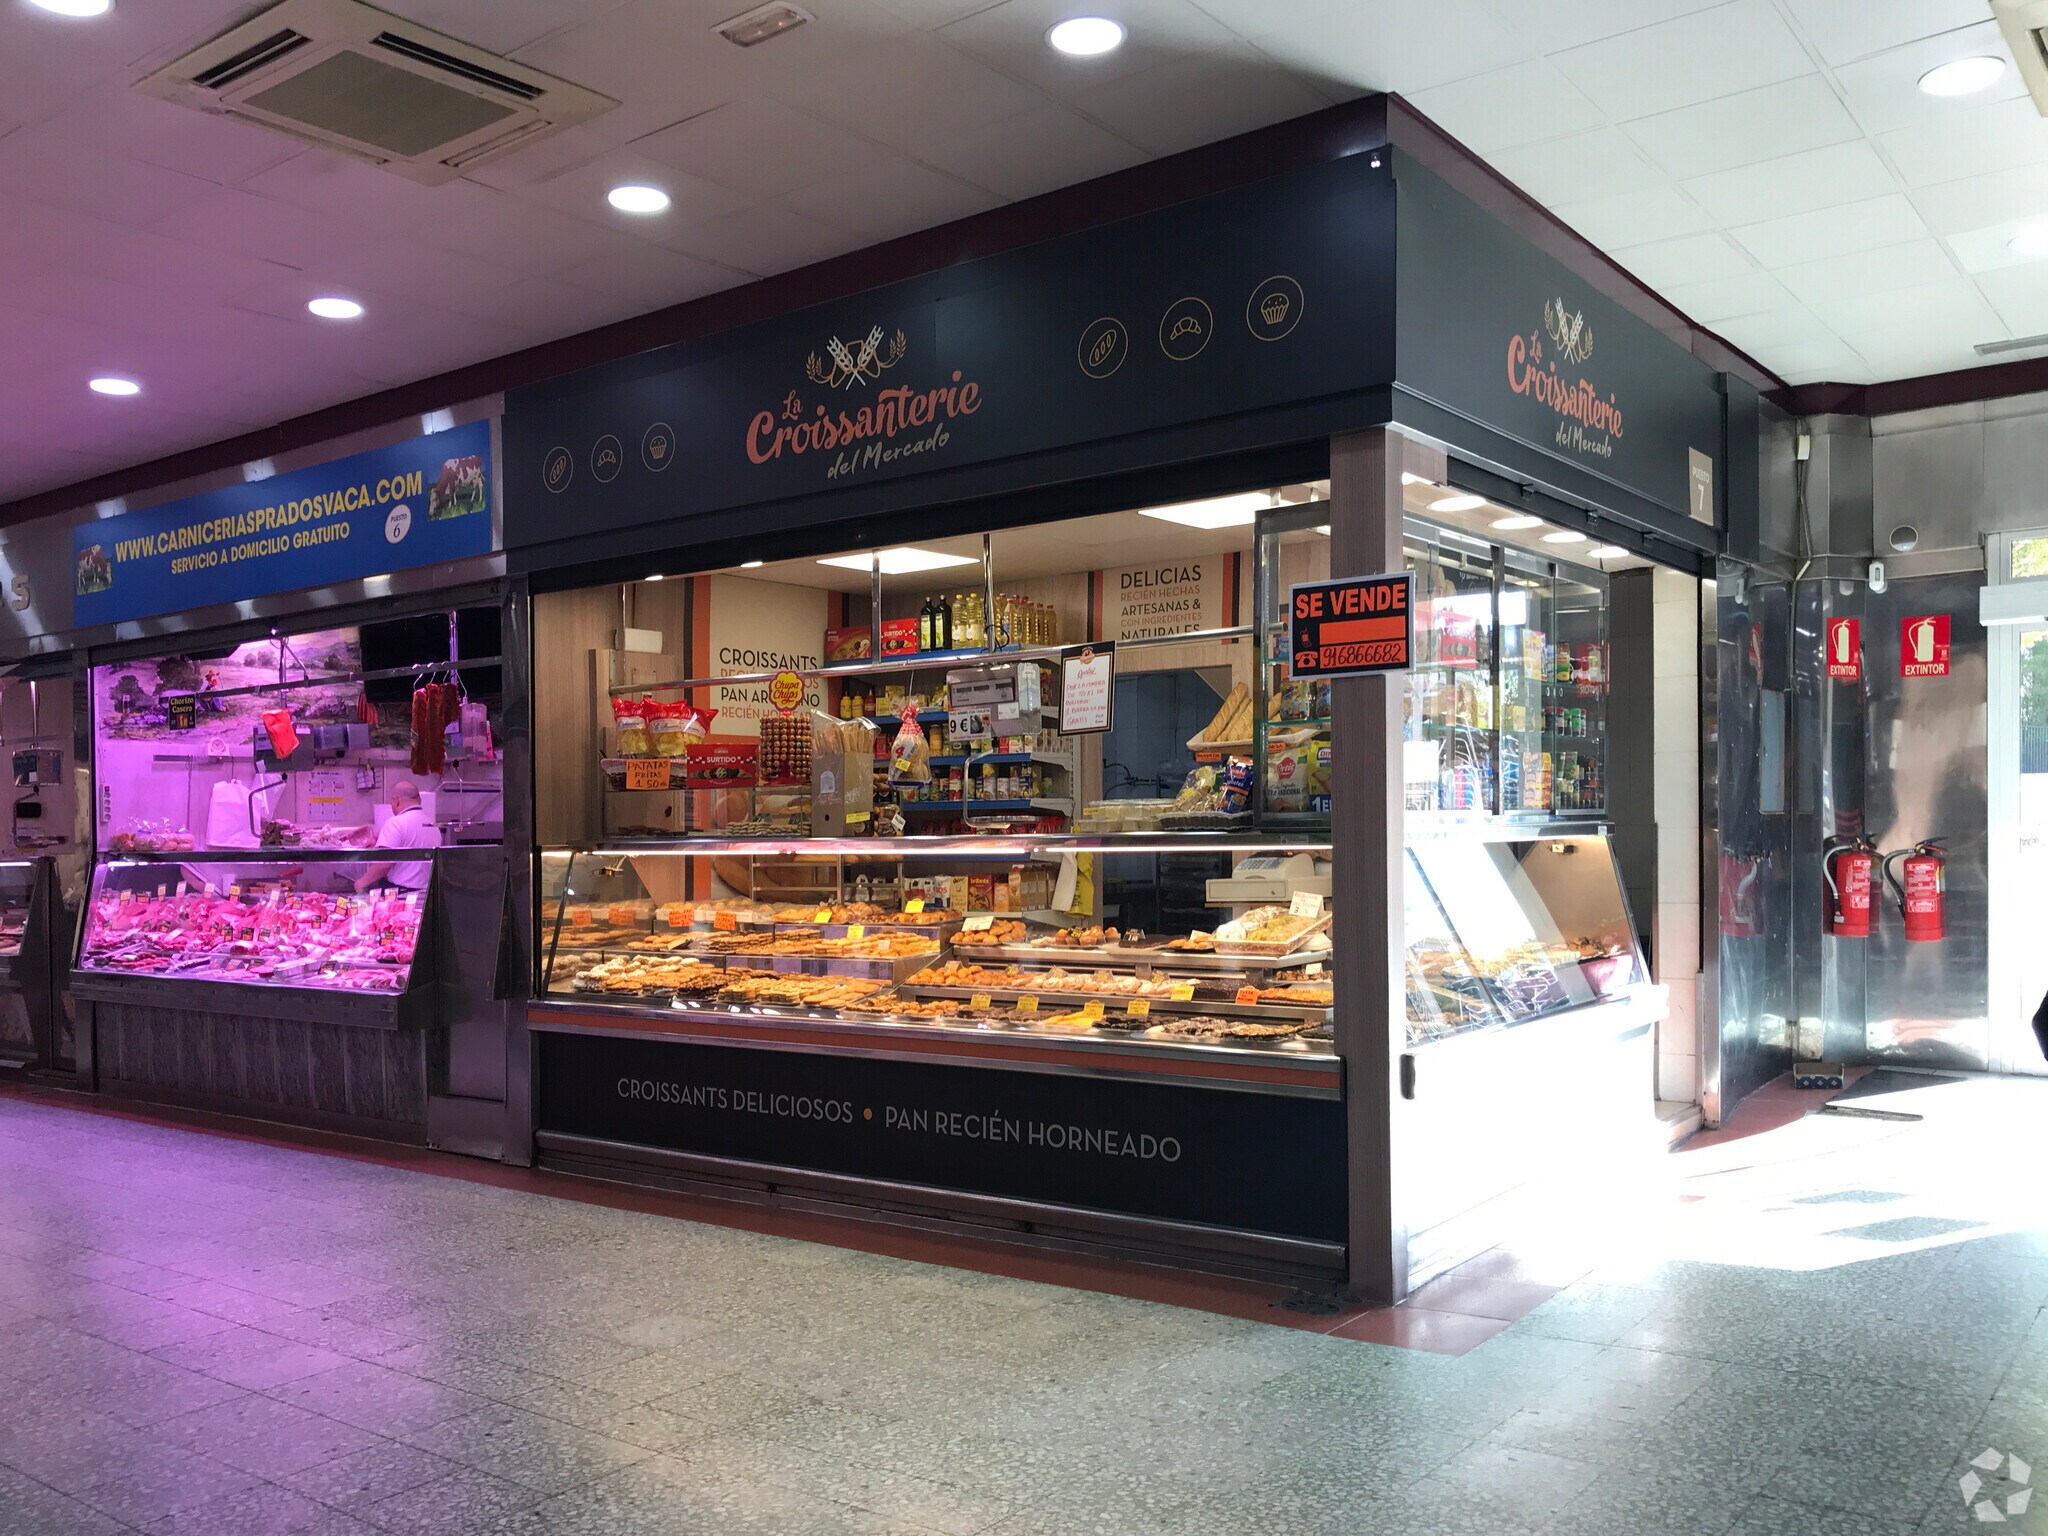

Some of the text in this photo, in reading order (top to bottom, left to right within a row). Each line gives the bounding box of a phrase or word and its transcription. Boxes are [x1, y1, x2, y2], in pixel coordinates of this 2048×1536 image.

[1530, 329, 1543, 364] La
[1507, 334, 1624, 439] Croissanterie
[783, 390, 803, 419] La
[746, 370, 982, 465] Croissanterie
[827, 422, 950, 479] del Mercado
[1555, 421, 1612, 459] del Mercado
[1698, 484, 1705, 511] 7
[115, 470, 423, 563] WWW.CARNICERIASPRADOSVACA.COM
[393, 524, 402, 539] 6
[171, 521, 350, 575] SERVICIO A DOMICILIO GRATUITO
[1121, 565, 1201, 589] DELICIAS
[1121, 585, 1200, 602] RECIÉN HECHAS
[1296, 583, 1406, 619] SE VENDE
[1121, 598, 1201, 617] ARTESANAS &
[1120, 612, 1203, 628] CON INGREDIENTES
[720, 647, 818, 670] CROISSANTS
[1323, 643, 1402, 667] 916866682
[1830, 665, 1857, 677] EXTINTOR
[1905, 663, 1945, 676] EXTINTOR
[721, 687, 748, 702] PAN
[773, 689, 798, 704] Chups
[775, 680, 800, 693] Chupa
[722, 704, 760, 719] RECIÉN
[950, 718, 968, 733] 9 €
[628, 761, 668, 771] PATATAS
[706, 756, 737, 764] SURTIDO
[617, 1077, 1182, 1163] CROISSANTS DELICIOSOS PAN RECIÉN HORNEADO
